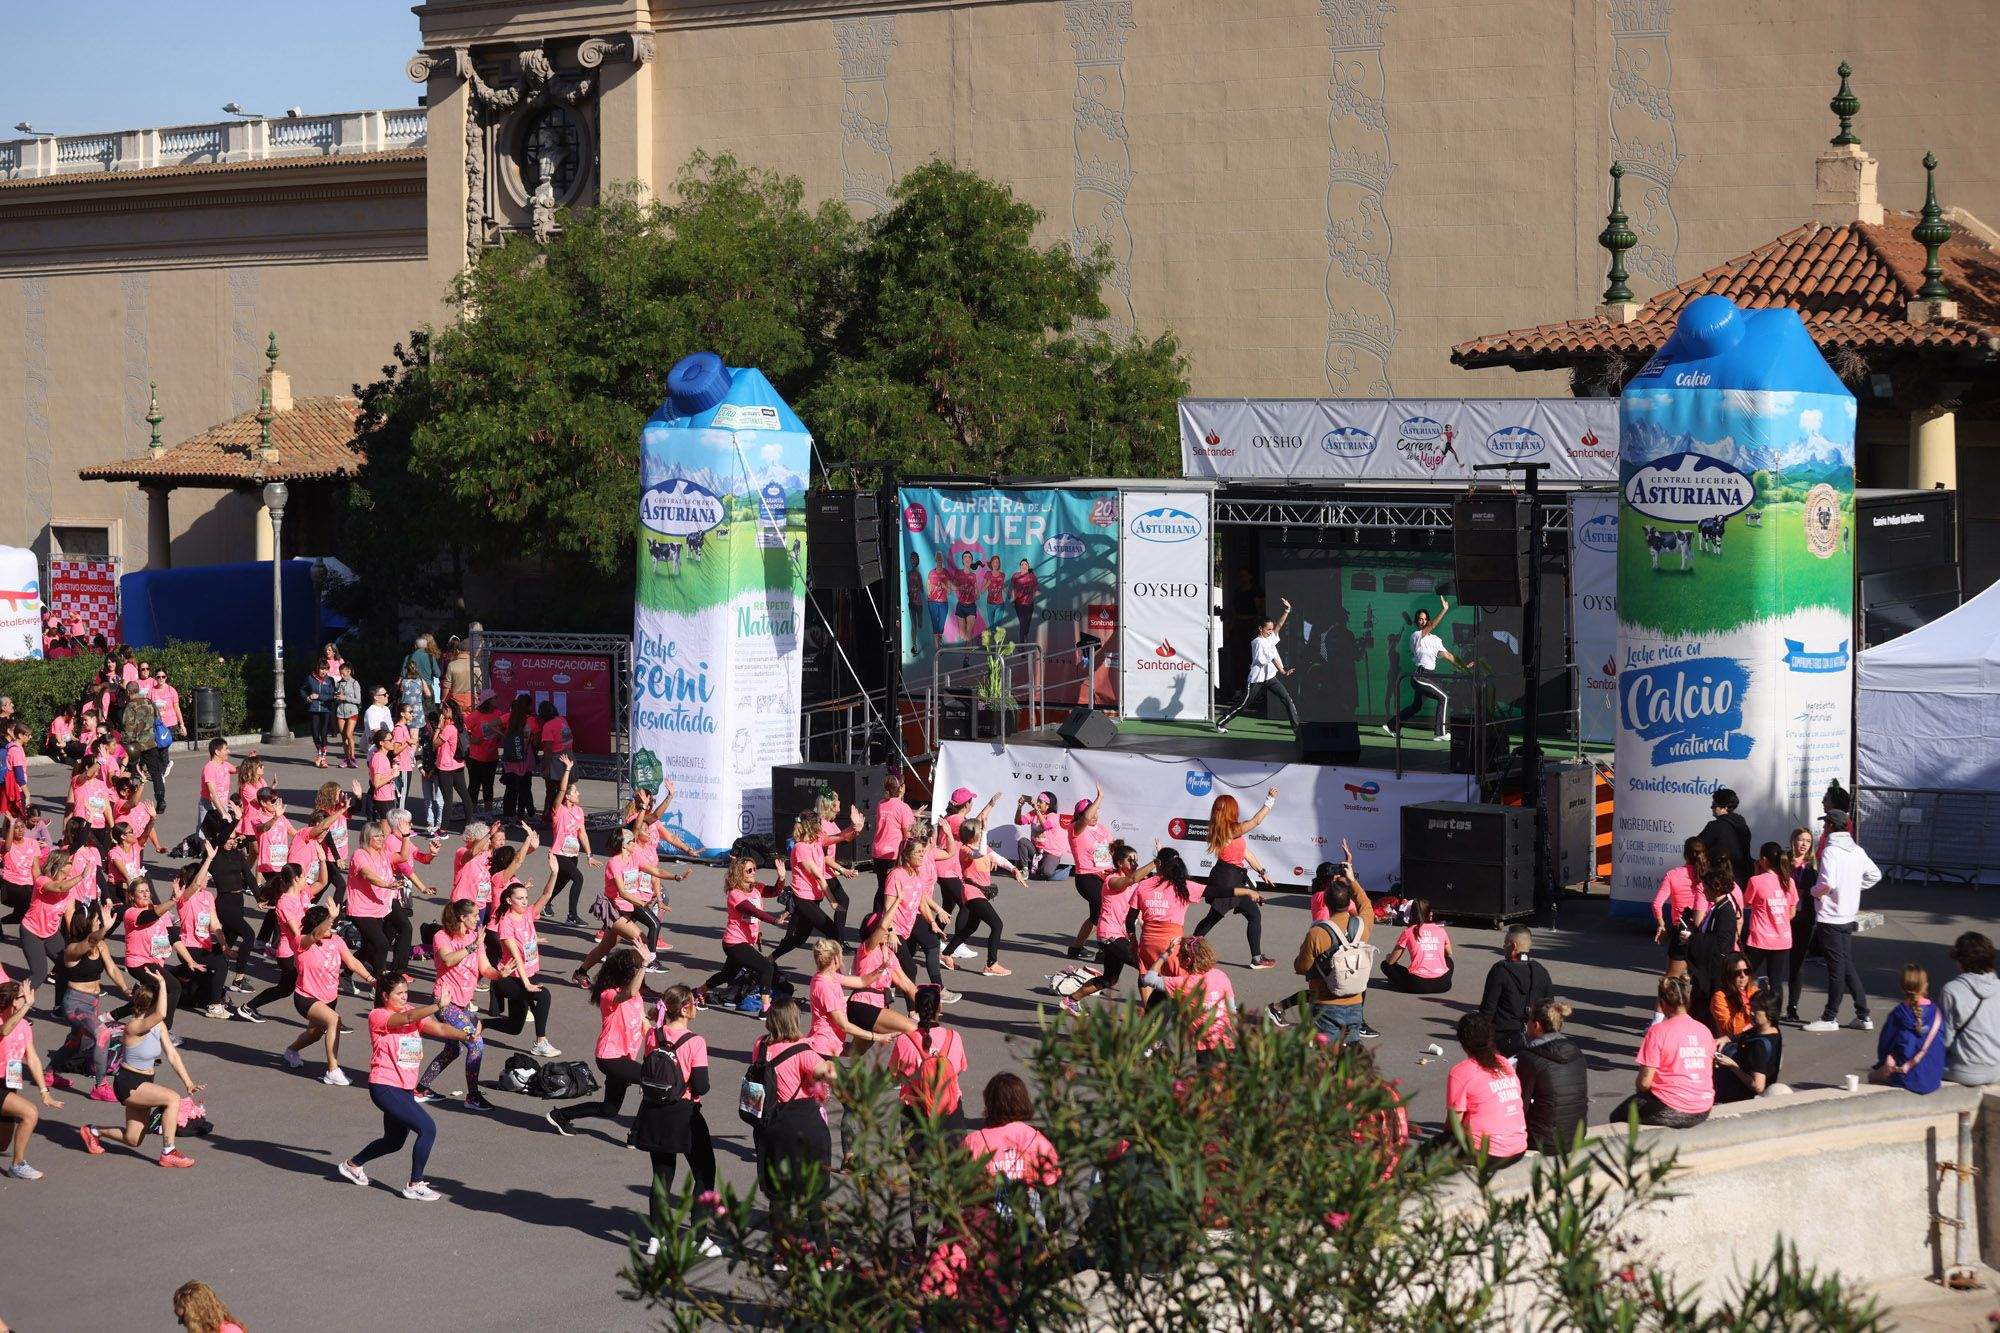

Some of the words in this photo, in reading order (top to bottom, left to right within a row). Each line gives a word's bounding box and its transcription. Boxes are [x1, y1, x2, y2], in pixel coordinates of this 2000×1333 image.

[1675, 370, 1711, 387] Calcio
[1404, 425, 1440, 435] ASTURIANA
[1252, 435, 1302, 449] OYSHO
[1325, 437, 1375, 450] ASTURIANA
[1396, 438, 1433, 450] Carrera
[1491, 438, 1546, 451] ASTURIANA
[1192, 446, 1236, 457] Santander
[1566, 447, 1615, 458] Santander
[1419, 451, 1445, 470] Mujer
[1651, 476, 1691, 484] CENTRAL
[1632, 477, 1744, 506] ASTURIANA
[641, 498, 716, 524] ASTURIANA
[940, 496, 1025, 513] CARRERA
[1028, 504, 1039, 513] DE
[1094, 500, 1111, 516] 20
[934, 514, 1046, 546] MUJER
[1136, 520, 1196, 534] ASTURIANA
[1584, 528, 1617, 543] ASTURI
[1047, 543, 1083, 553] ASTURIANA
[1134, 582, 1198, 598] OYSHO
[753, 601, 790, 610] RESPETO
[737, 607, 798, 638] Natural
[1042, 609, 1083, 622] OYSHO
[636, 630, 677, 665] Leche
[1624, 645, 1654, 668] Leche
[1658, 644, 1682, 660] rica
[1687, 643, 1702, 656] en
[1137, 659, 1195, 671] Santander
[634, 661, 714, 703] semi
[1627, 671, 1733, 729] Calcio
[633, 702, 718, 735] desnatada
[1669, 731, 1730, 756] natural
[1012, 772, 1070, 783] VOLVO
[1344, 803, 1379, 812] TotalEnergies
[1188, 828, 1208, 836] Barcelo
[1248, 833, 1281, 842] nutribullet
[1626, 840, 1645, 851] LECHE
[1647, 842, 1685, 853] SEMIDESNAT
